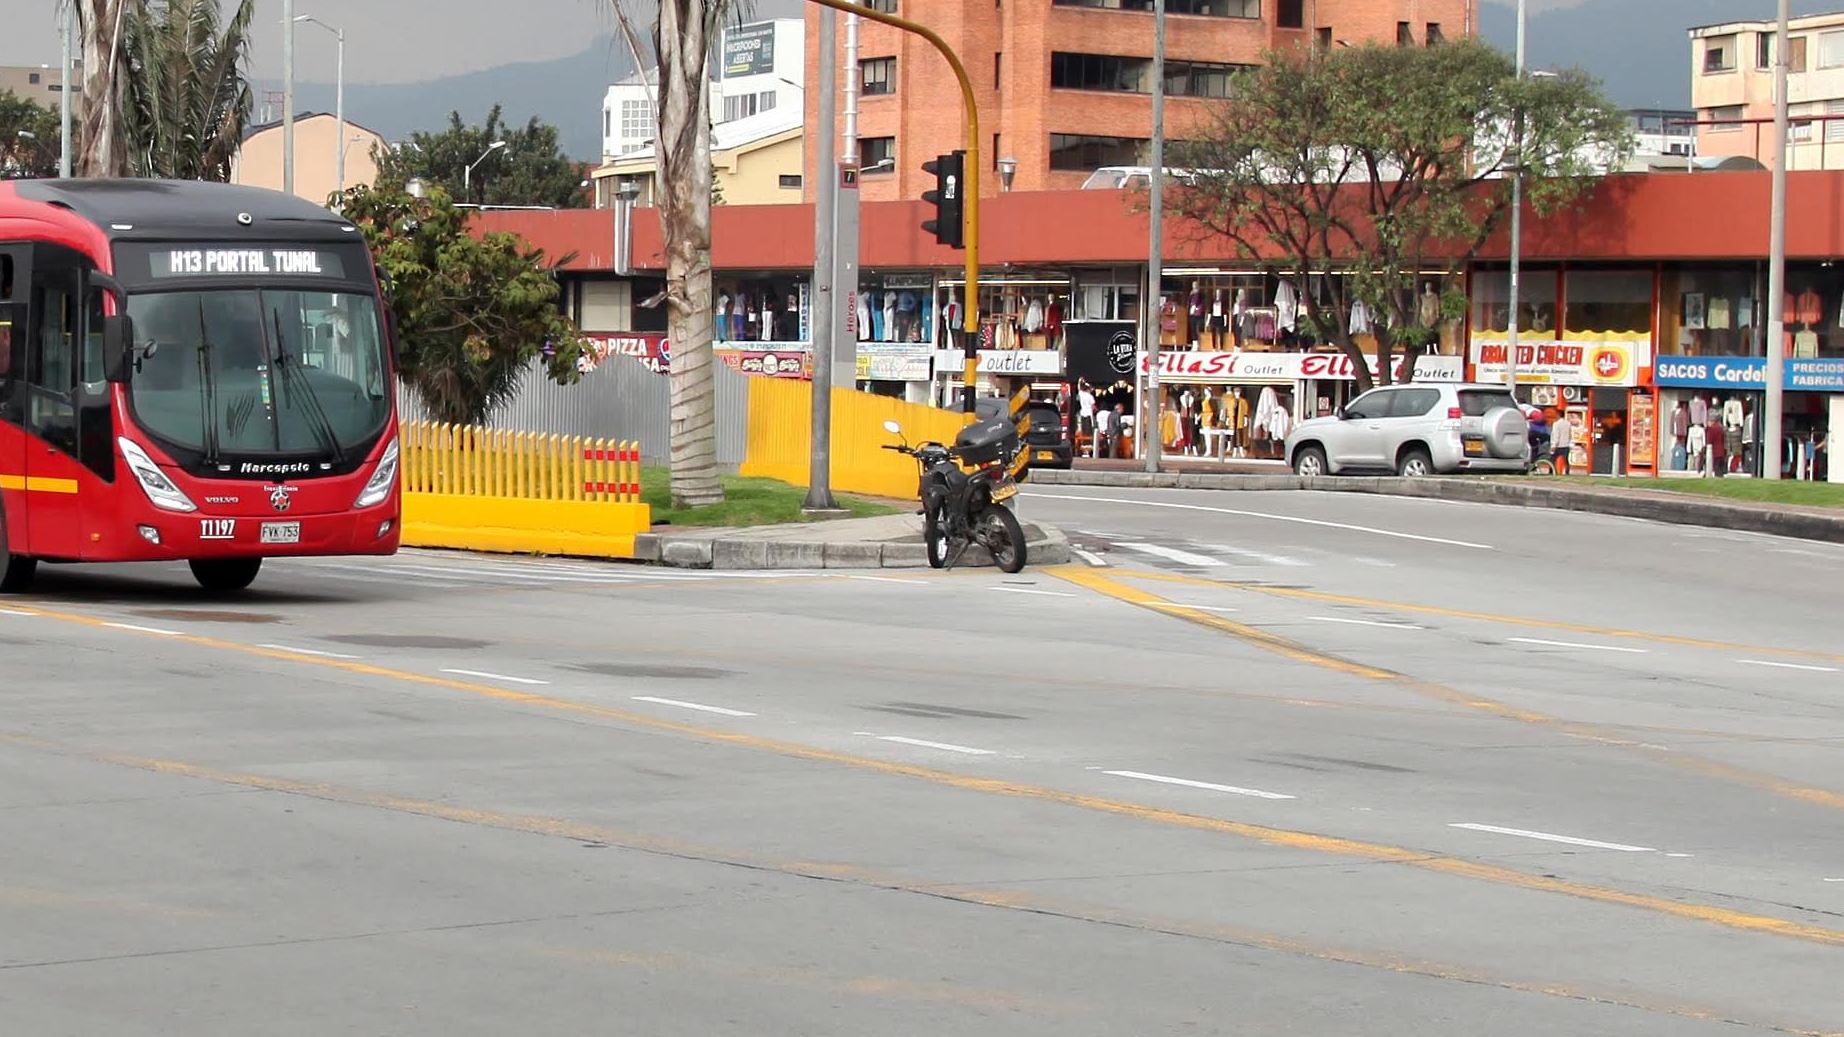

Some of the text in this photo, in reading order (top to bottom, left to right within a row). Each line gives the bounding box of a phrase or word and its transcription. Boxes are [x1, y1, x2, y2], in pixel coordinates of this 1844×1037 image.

[171, 250, 321, 273] H13 PORTAL TUNAL
[607, 338, 648, 356] PIZZA
[986, 352, 1032, 371] outlet
[1480, 345, 1584, 366] BROATED CHICKEN
[1244, 365, 1283, 375] Outlet
[1413, 367, 1456, 378] Outlet
[1658, 363, 1707, 379] SACOS
[1792, 363, 1844, 373] PRECIOS
[1792, 375, 1844, 386] FABRICA
[241, 462, 310, 474] Marcopolo
[204, 496, 239, 504] VOLVO
[201, 519, 236, 536] T1197
